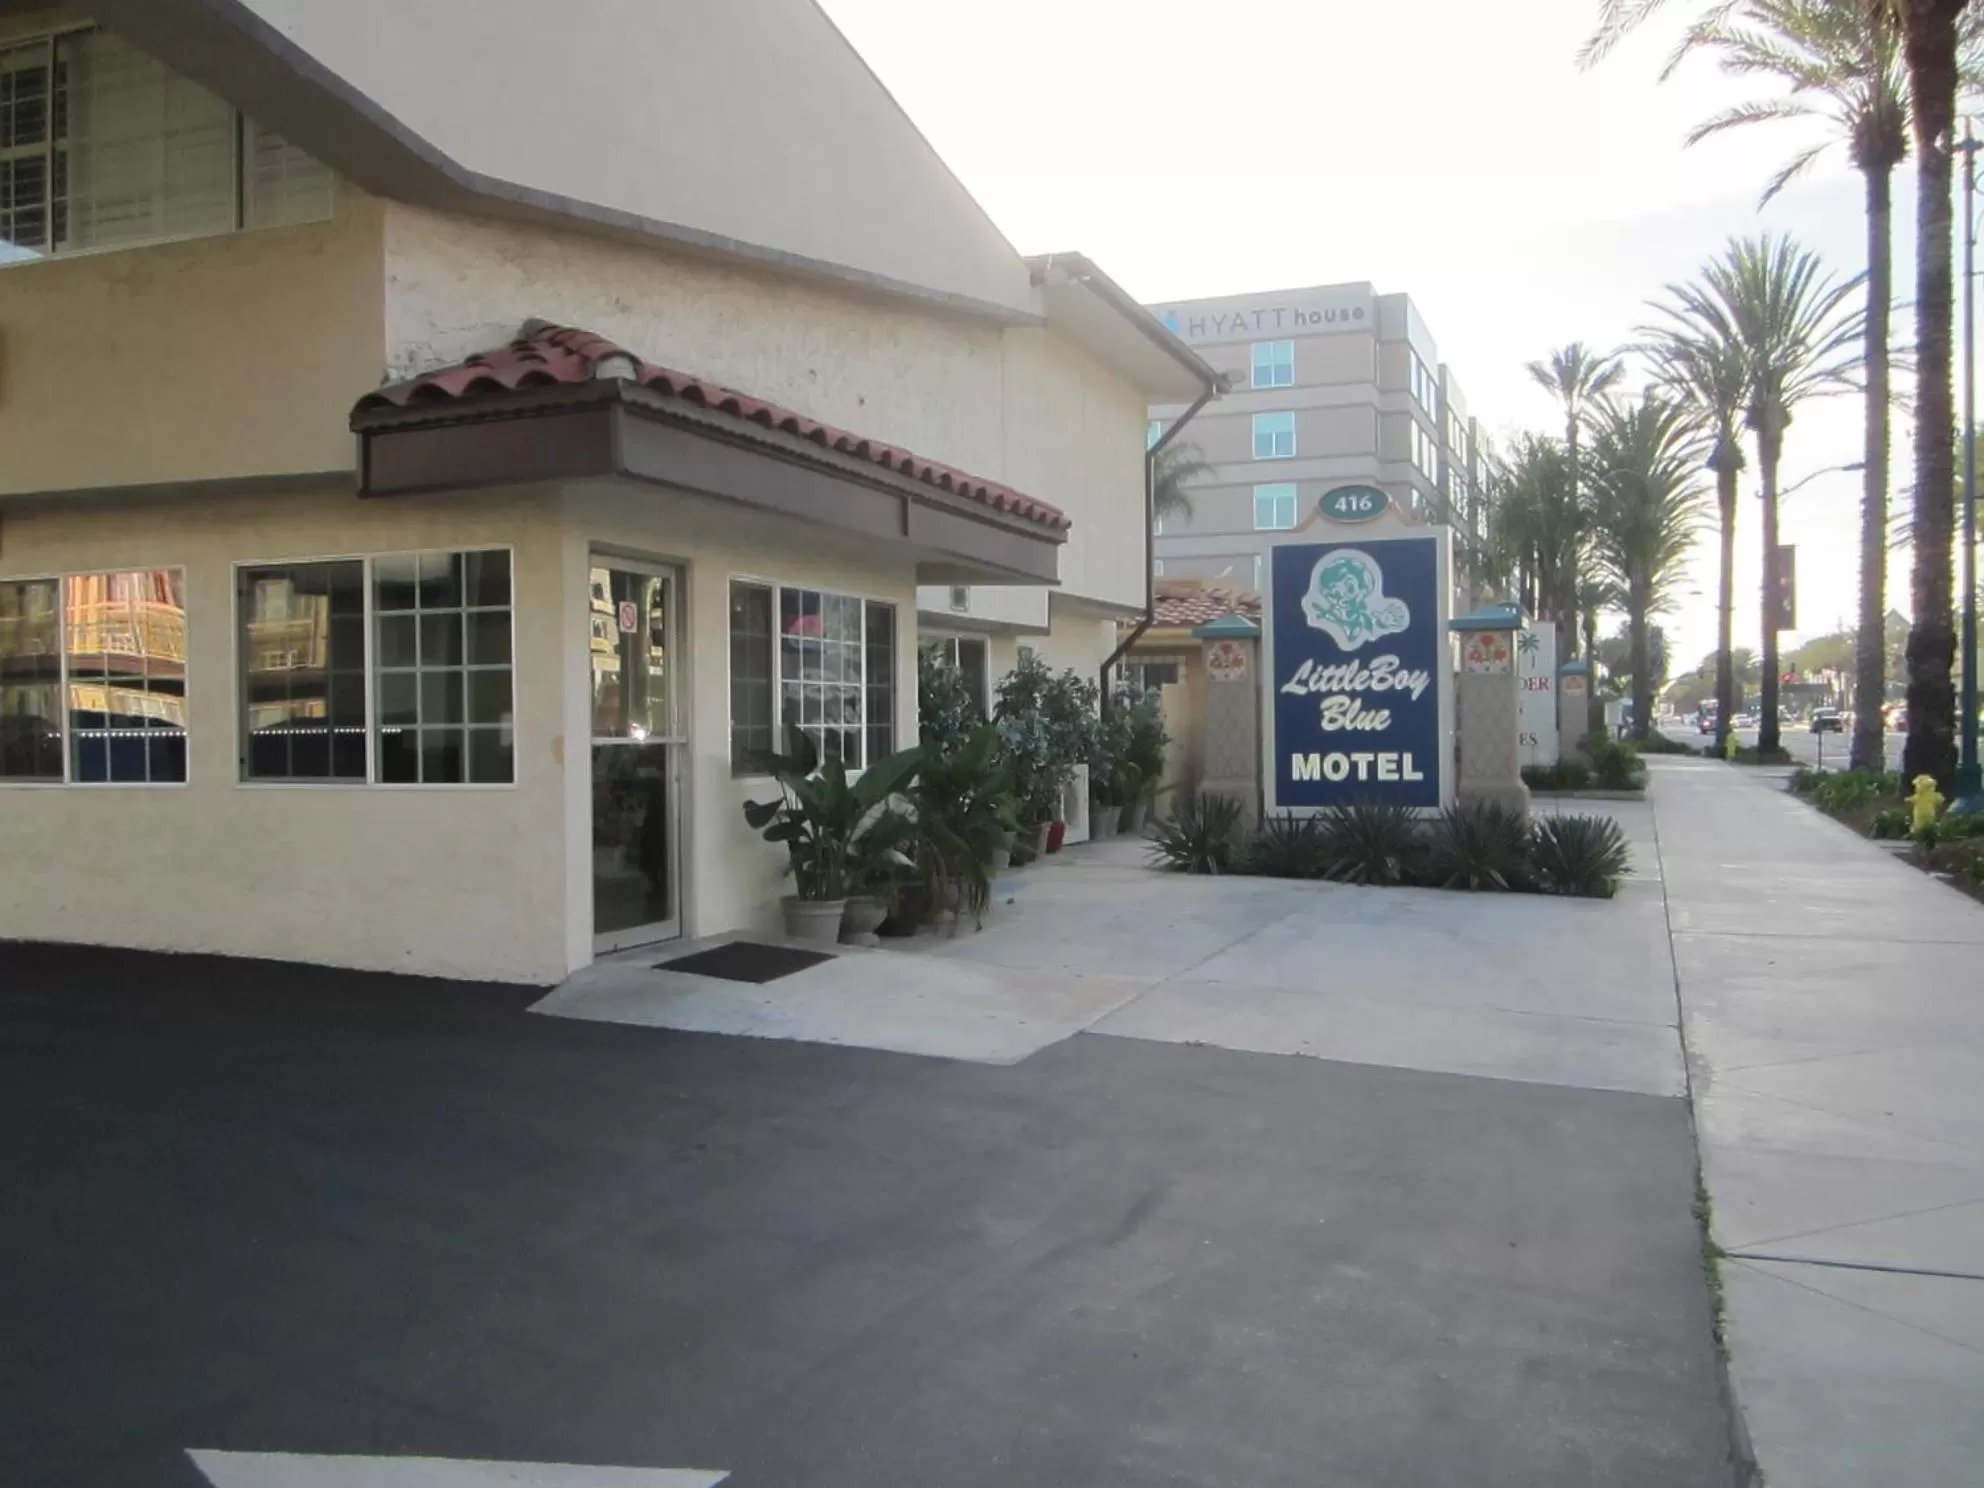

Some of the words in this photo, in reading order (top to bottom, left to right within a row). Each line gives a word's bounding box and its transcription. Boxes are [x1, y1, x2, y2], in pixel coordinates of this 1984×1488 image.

[1189, 308, 1286, 337] HYATT
[1294, 306, 1365, 327] house
[1334, 494, 1373, 513] 416
[1320, 695, 1392, 731] Blue
[1291, 752, 1424, 781] MOTEL
